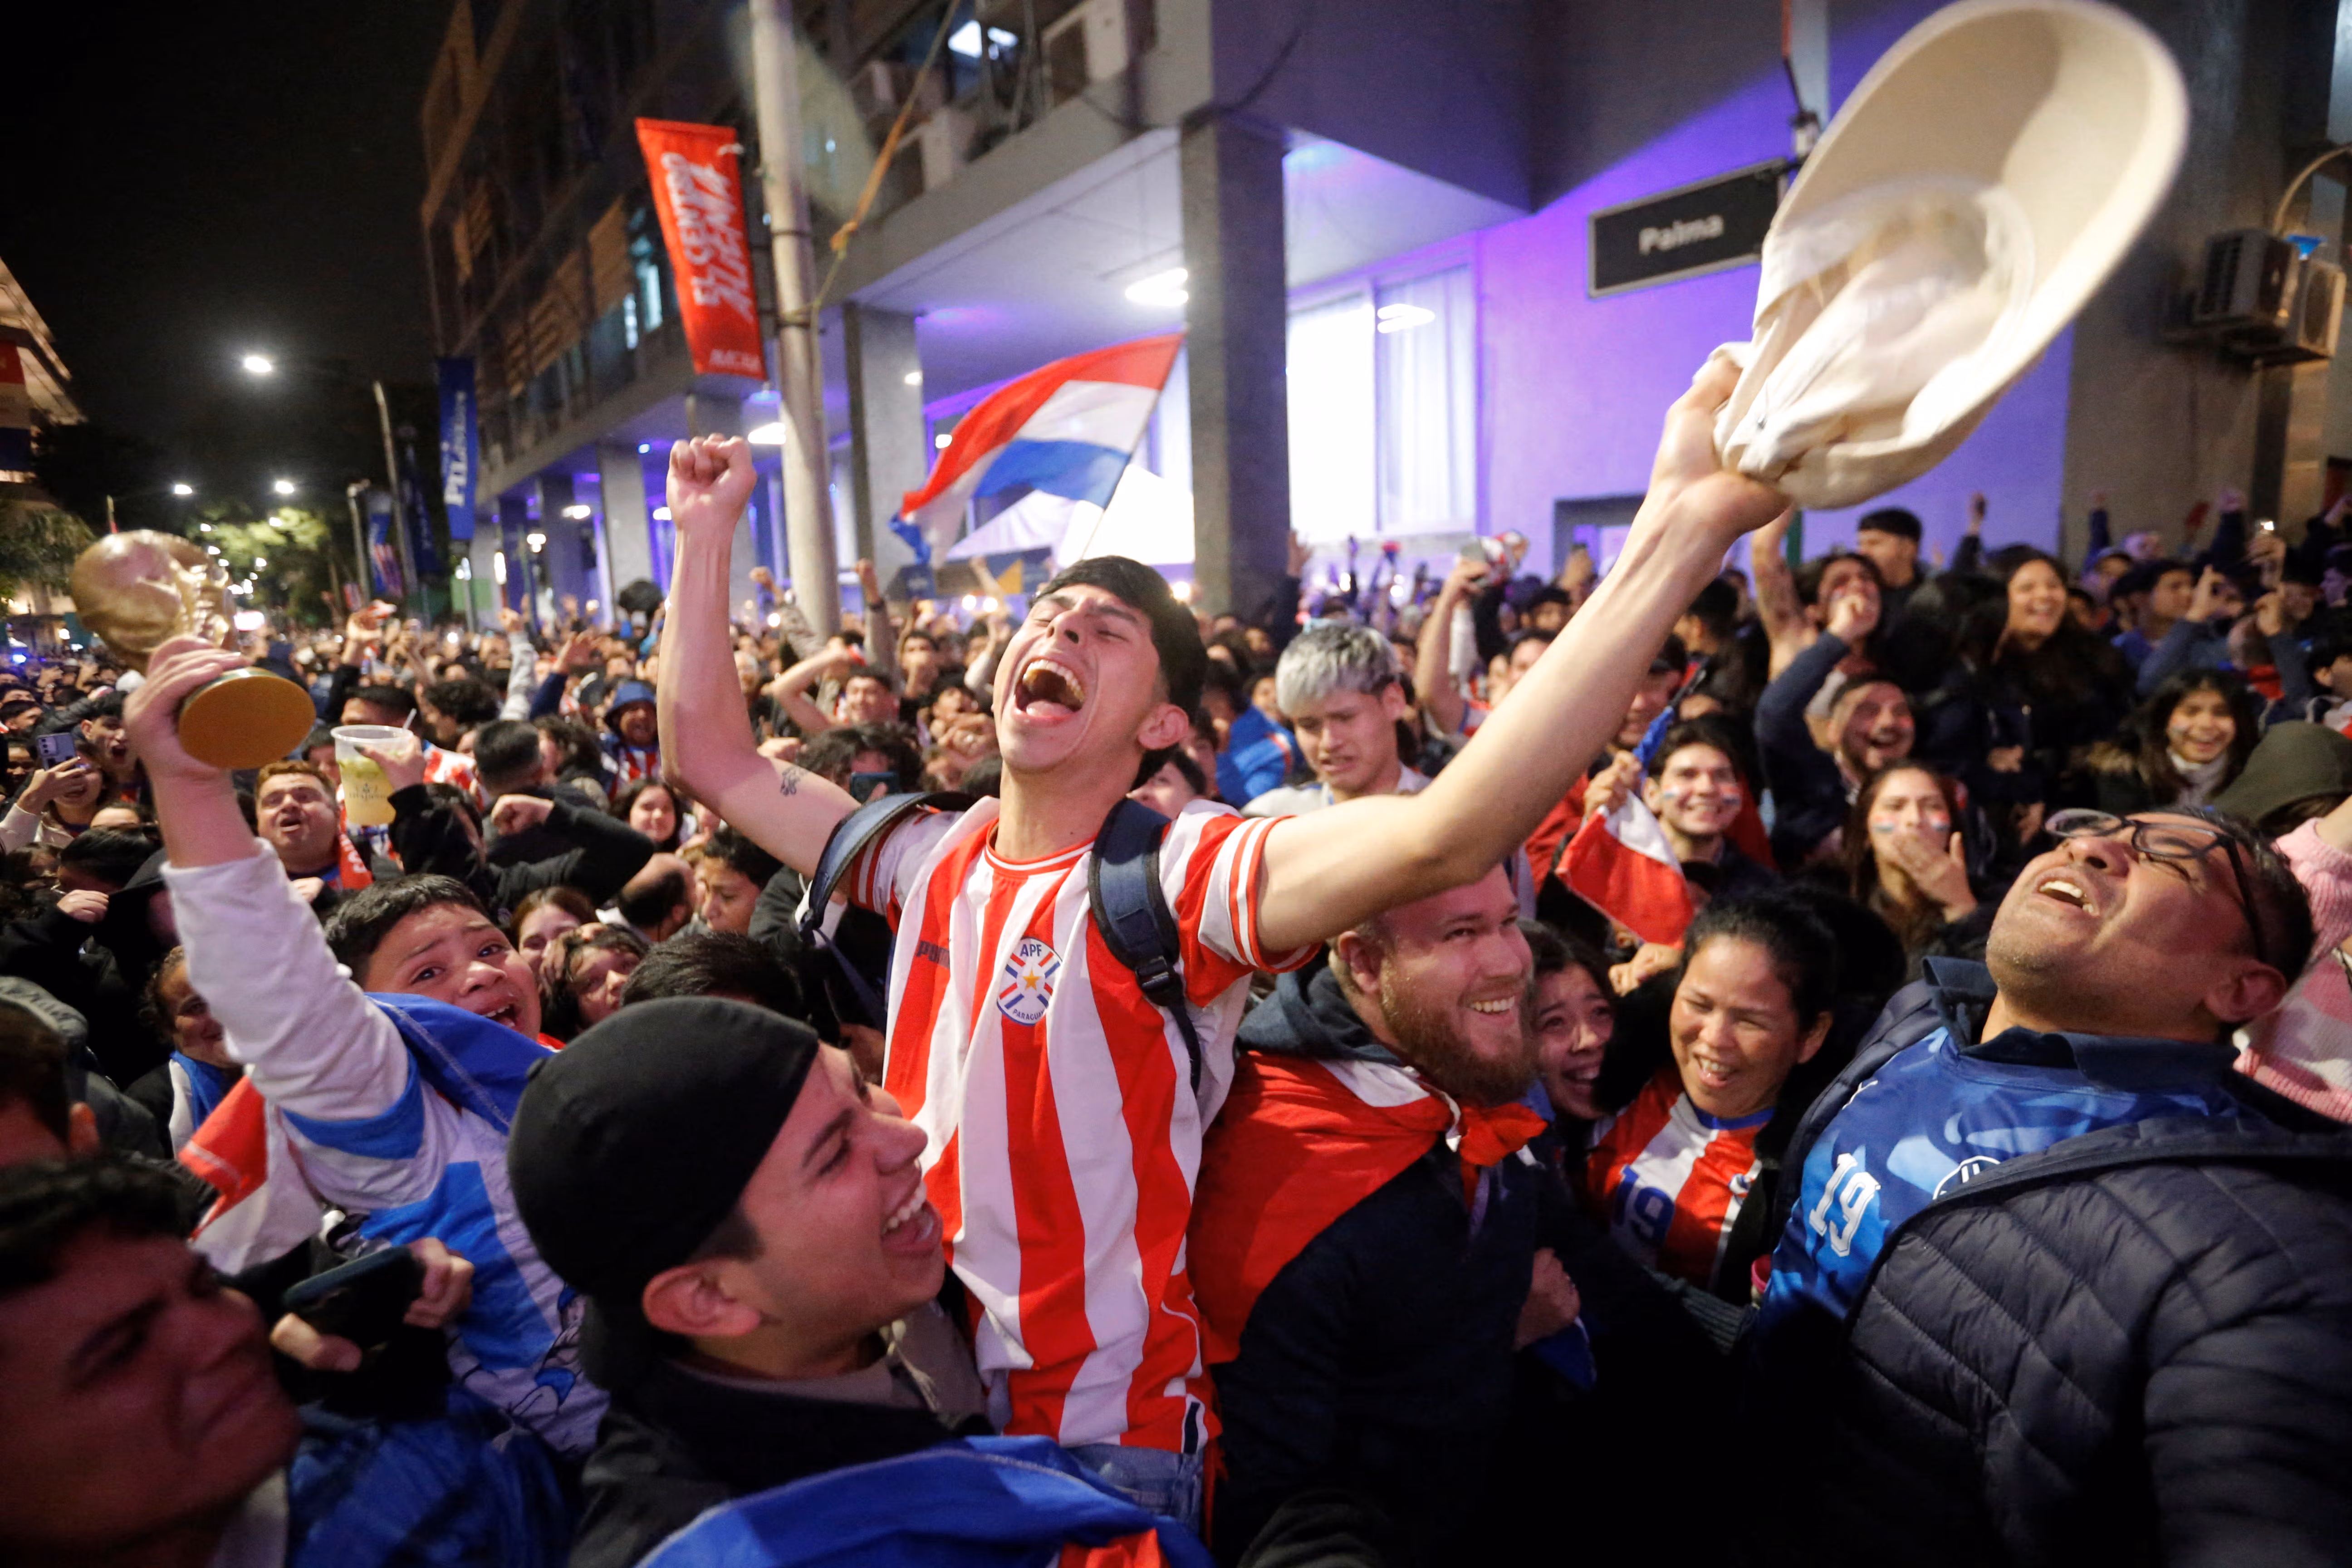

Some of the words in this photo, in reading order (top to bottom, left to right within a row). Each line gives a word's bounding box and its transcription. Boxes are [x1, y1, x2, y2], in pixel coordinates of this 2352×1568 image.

[1639, 214, 1723, 255] Palma
[1020, 944, 1042, 957] APF
[1614, 1164, 1675, 1246] 19
[1809, 1153, 1881, 1257] 19
